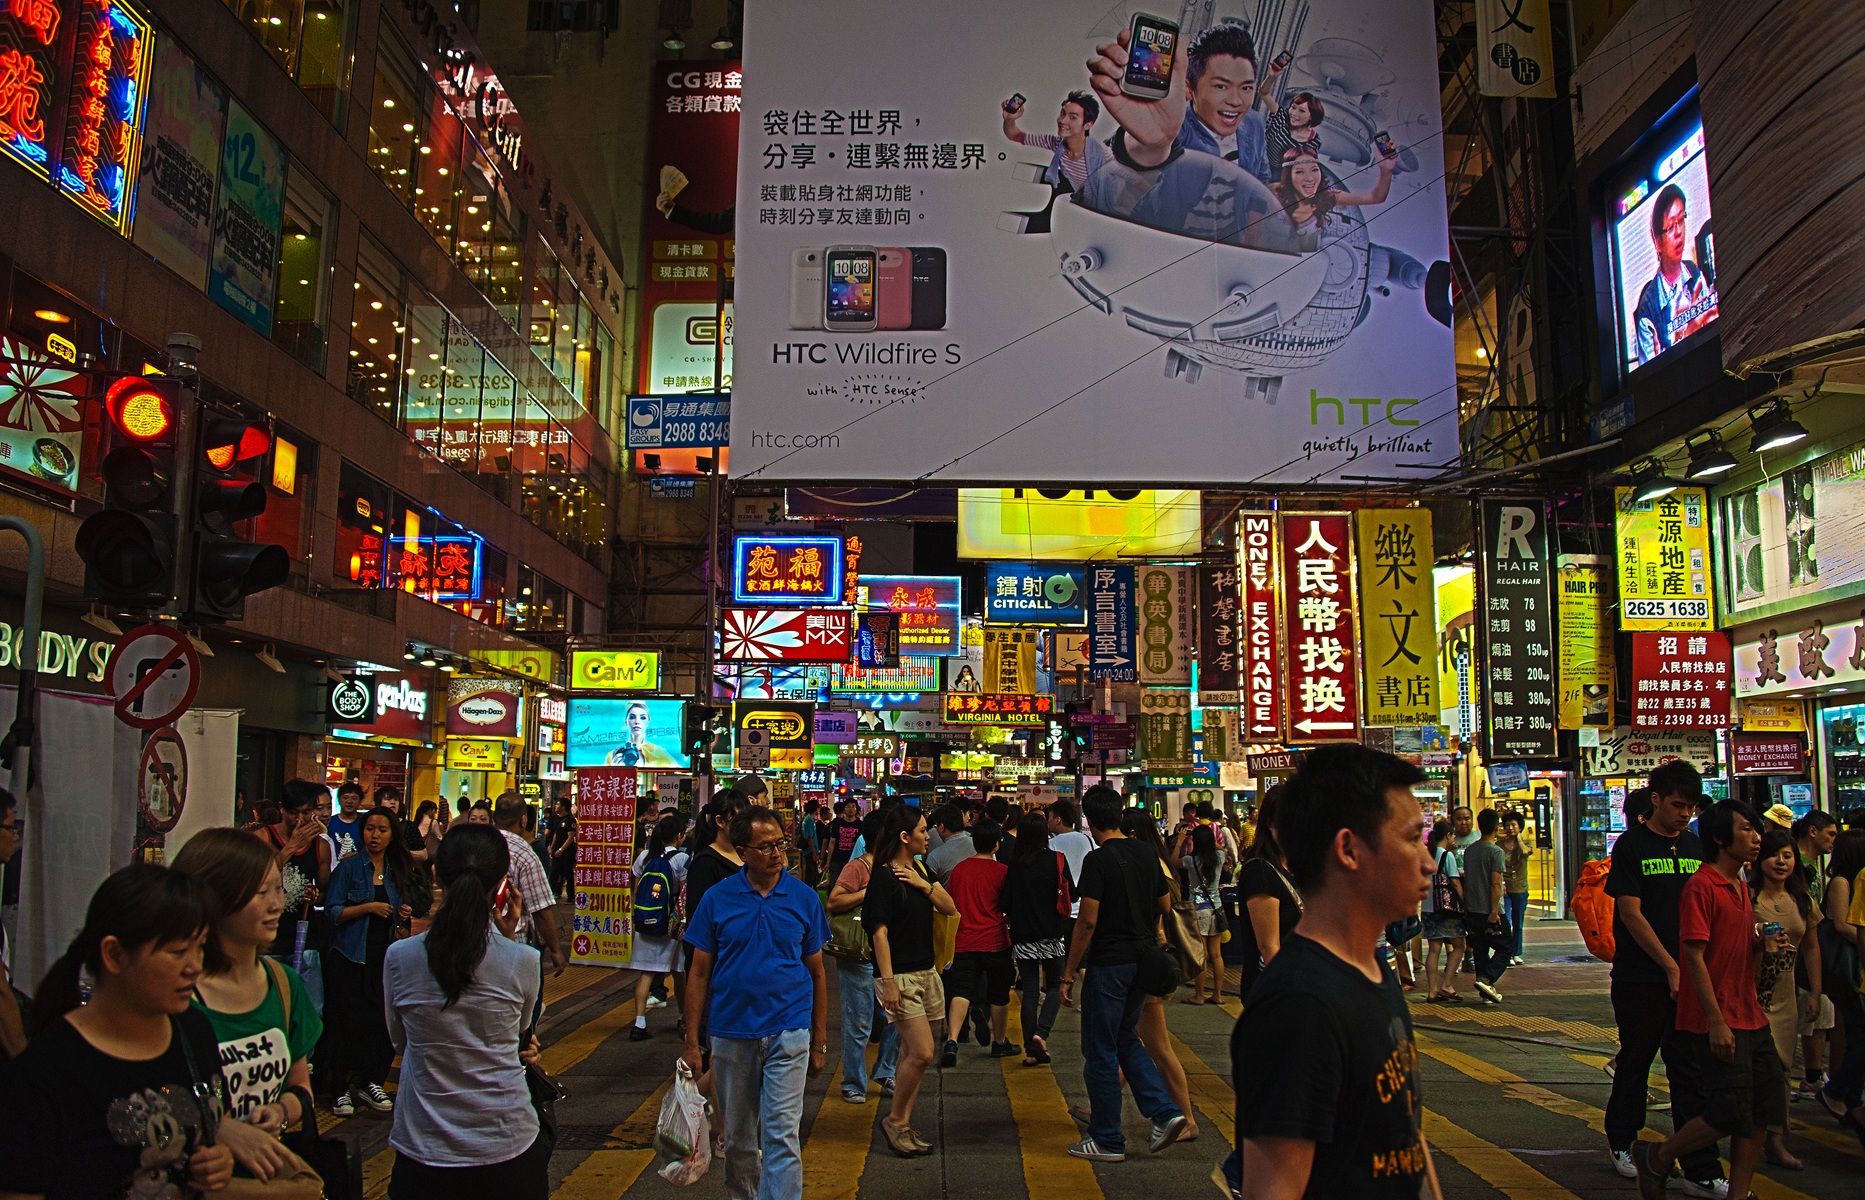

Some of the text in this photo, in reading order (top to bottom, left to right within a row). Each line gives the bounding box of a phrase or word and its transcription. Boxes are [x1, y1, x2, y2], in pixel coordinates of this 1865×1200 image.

[666, 95, 742, 119] 各類貸款
[667, 244, 704, 259] 清卡數
[660, 267, 709, 282] 現金貸款
[773, 342, 961, 365] HTC Wildfire S
[663, 376, 712, 393] 申請熱線
[807, 383, 917, 400] with HTC Sense
[664, 401, 731, 417] 易通集團
[664, 422, 730, 442] 2988 8348
[751, 430, 840, 448] htc.com
[1303, 435, 1432, 461] quietly brilliant
[1496, 506, 1536, 559] R
[1657, 493, 1686, 596] 金源地產
[1497, 561, 1540, 572] HAIR
[996, 575, 1044, 598] 鐳射
[1565, 581, 1608, 595] HAIR PRO
[993, 599, 1052, 610] CITICALL
[1490, 597, 1536, 611] 洗吹 78
[1628, 602, 1706, 616] 2625 1638
[1094, 568, 1118, 656] 序言書室
[1246, 518, 1272, 720] MONEY EXCHANGE
[1295, 520, 1346, 714] 人民幣找換
[806, 614, 850, 631] 美心
[1148, 574, 1169, 669] 華英書局
[1491, 619, 1537, 632] 洗剪 98
[985, 632, 1036, 644] 學生書屋
[1492, 643, 1512, 657] 焗油
[1493, 667, 1513, 681] 染髮
[1659, 662, 1726, 674] 人民幣找換店
[344, 690, 358, 698] THE
[1376, 674, 1431, 708] 書店
[1565, 690, 1580, 702] 2/F
[339, 697, 362, 705] BODY
[1494, 692, 1513, 706] 電髮
[340, 703, 361, 711] SHOP
[462, 706, 503, 718] Häagen-Dazs
[957, 713, 1042, 721] VIRGINIA HOTEL
[1495, 716, 1524, 730] 負離子
[1698, 714, 1727, 725] 2833
[758, 759, 769, 767] 12
[1252, 755, 1291, 770] MONEY
[1763, 752, 1798, 760] EXCHANGE
[1641, 858, 1676, 876] CEDAR
